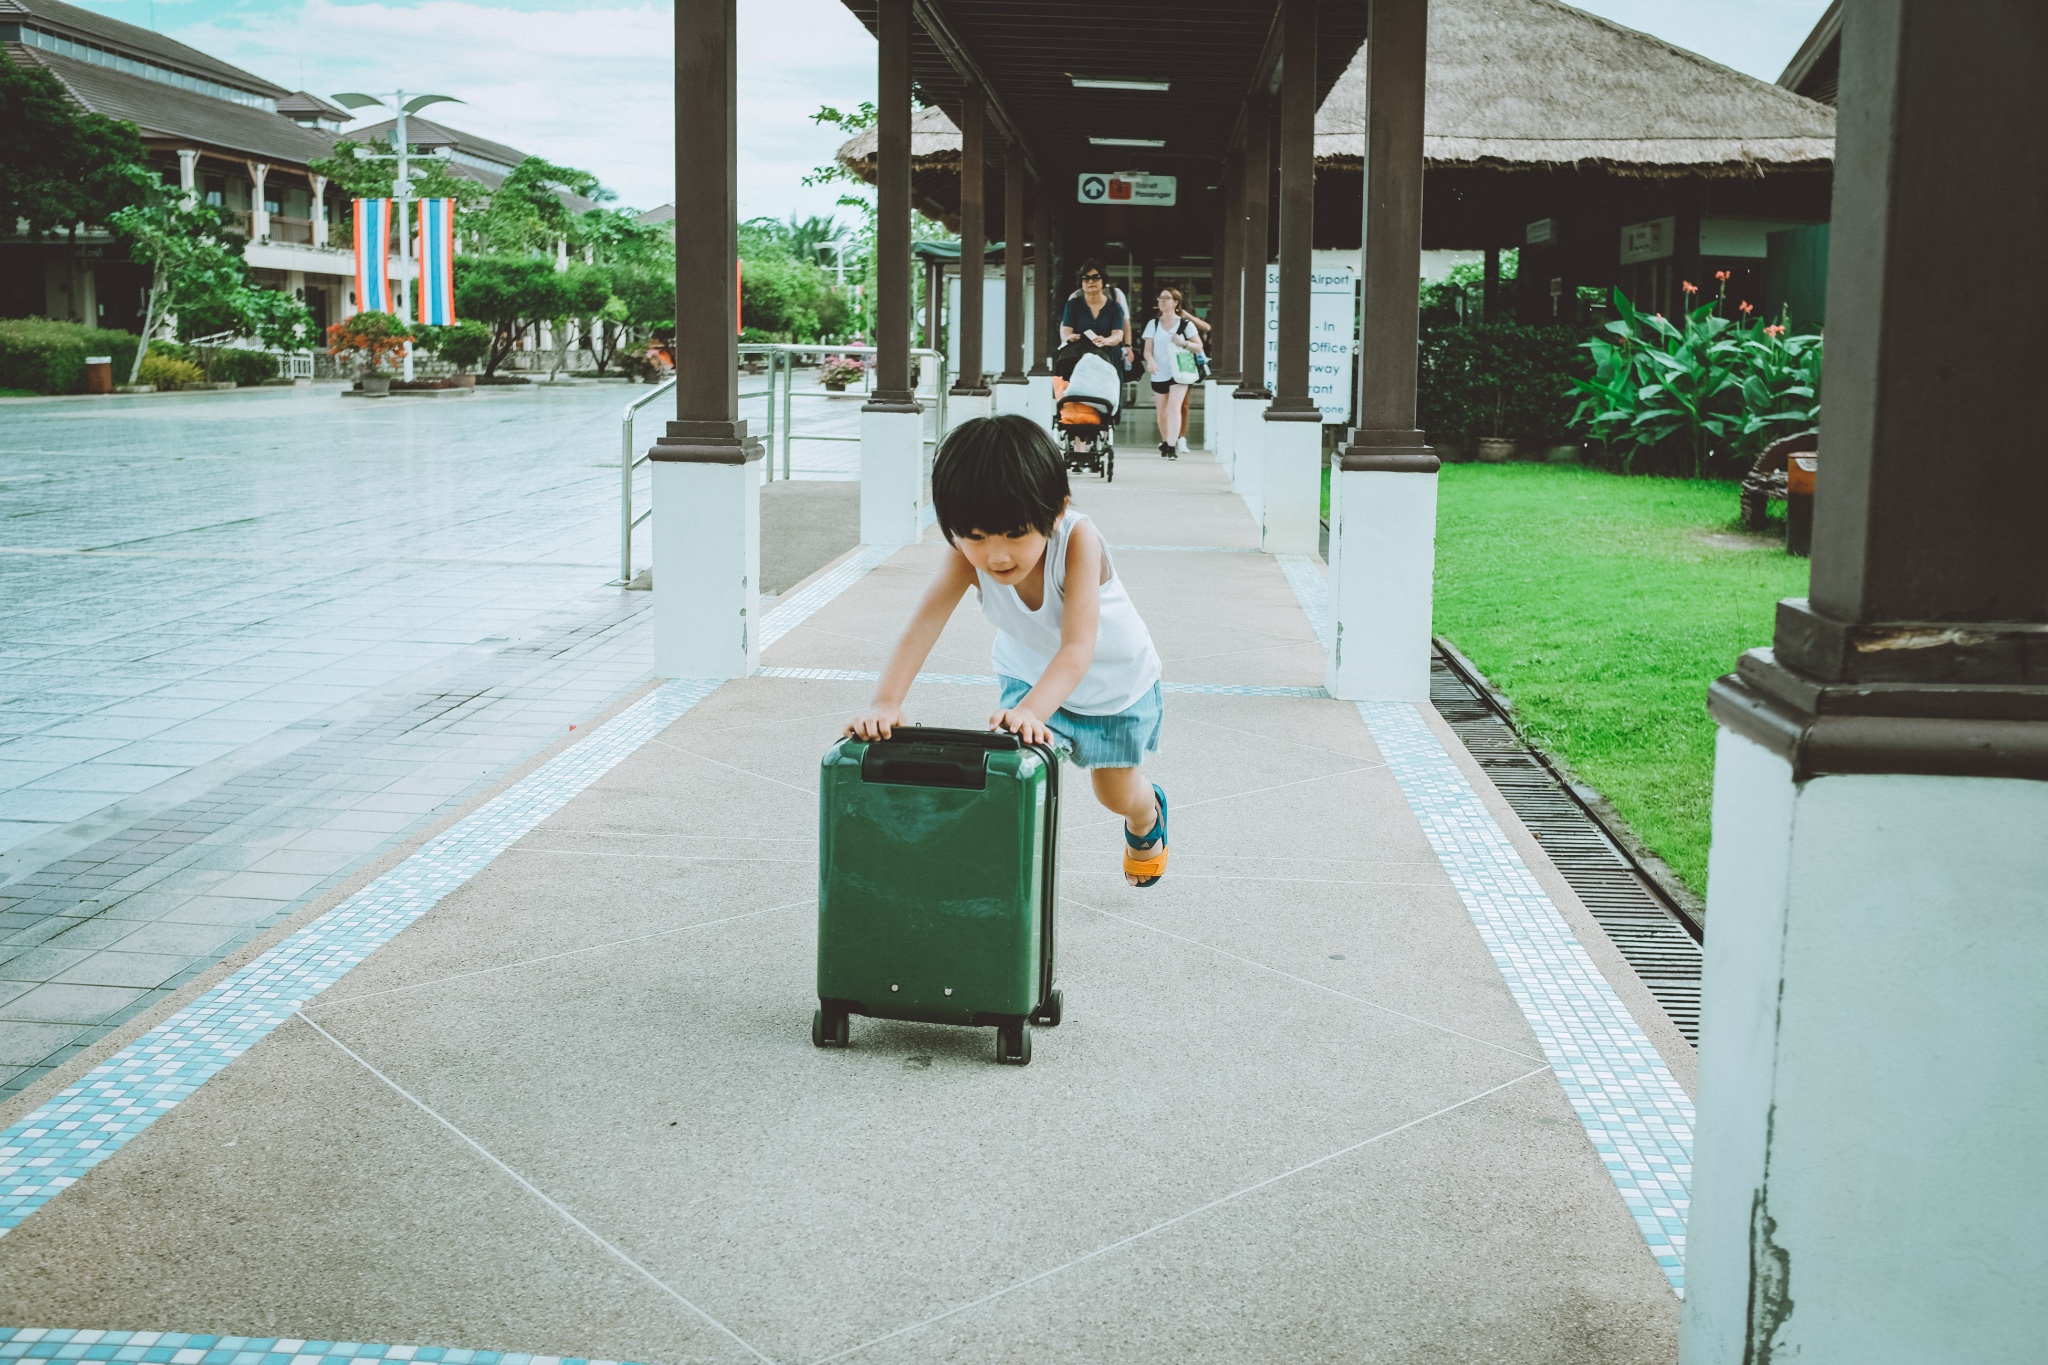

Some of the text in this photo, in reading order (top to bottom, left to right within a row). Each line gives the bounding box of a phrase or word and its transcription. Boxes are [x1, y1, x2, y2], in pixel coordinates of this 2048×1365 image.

[1135, 191, 1171, 199] Passenger
[1311, 274, 1349, 286] Airport
[1323, 321, 1335, 331] In
[1310, 342, 1347, 353] Office
[1309, 365, 1340, 376] rway
[1318, 404, 1344, 413] hone
